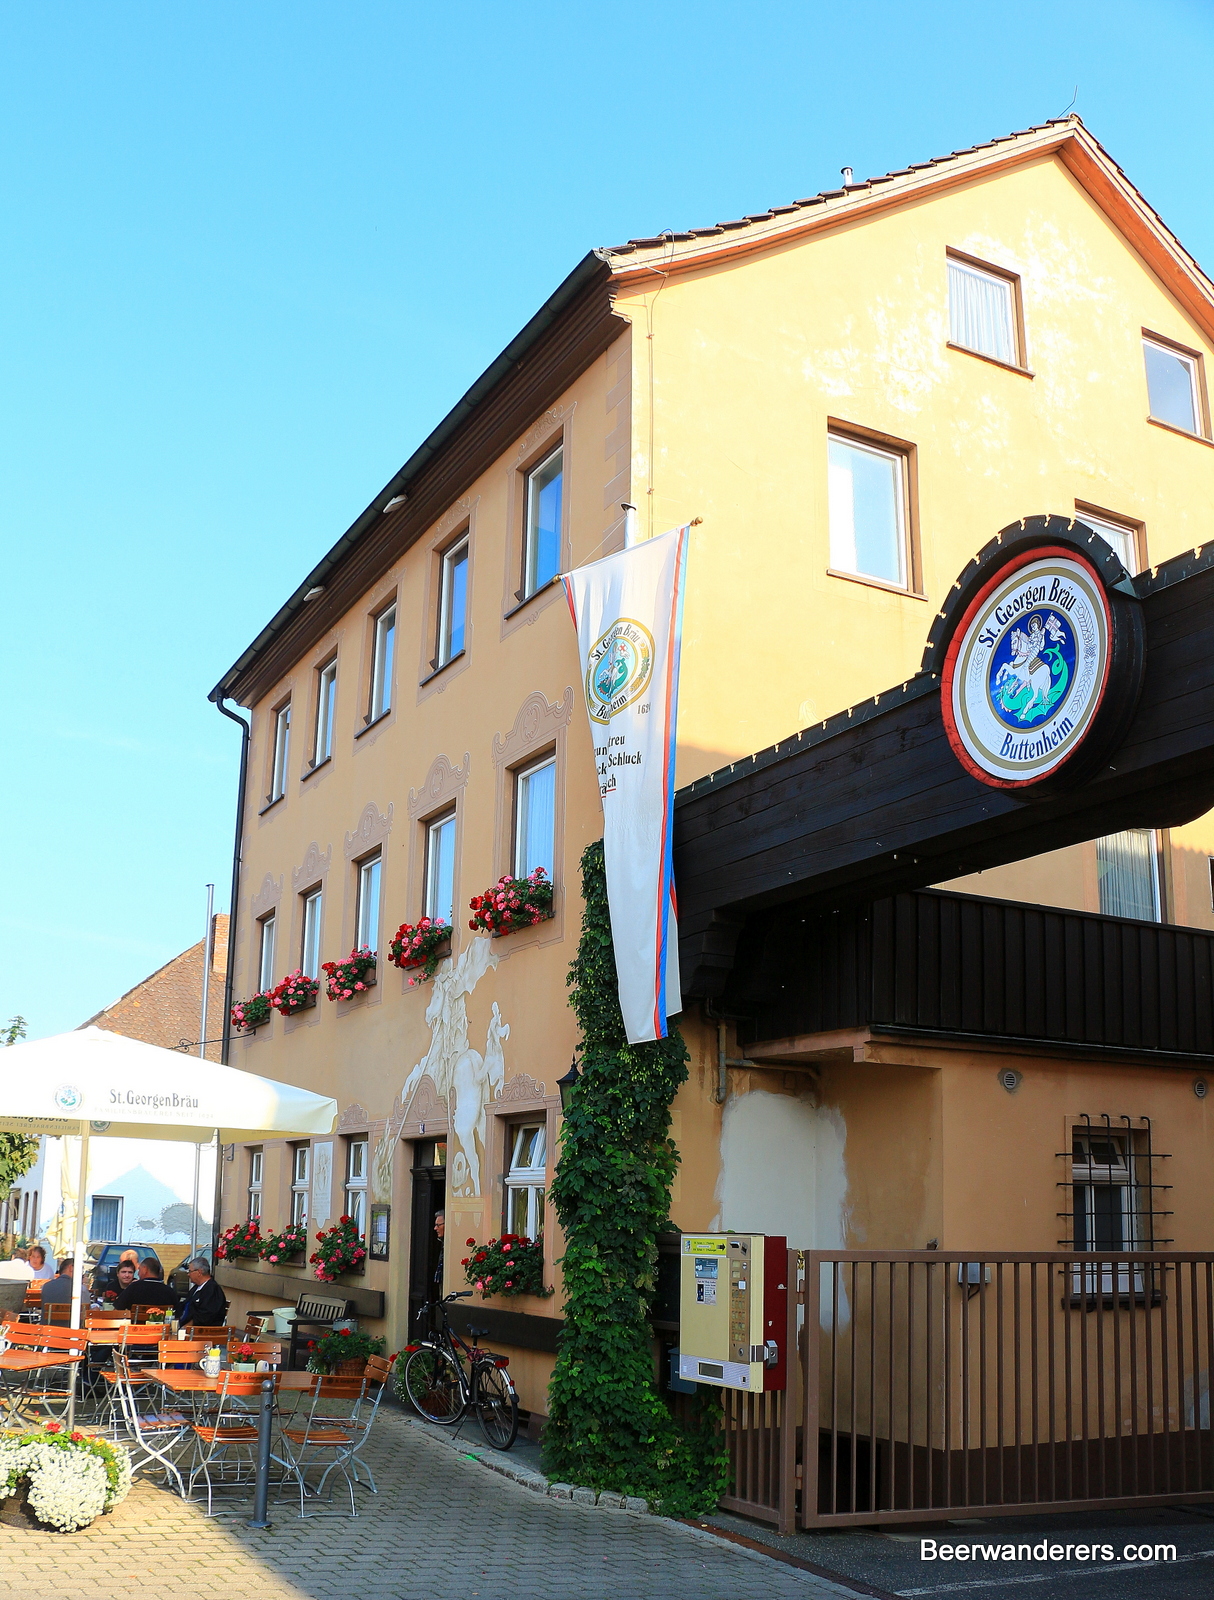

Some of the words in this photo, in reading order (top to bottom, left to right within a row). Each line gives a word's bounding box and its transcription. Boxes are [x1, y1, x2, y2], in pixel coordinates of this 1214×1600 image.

[978, 626, 1001, 649] St.
[995, 584, 1046, 625] Georgen
[1048, 577, 1077, 612] Bräu
[623, 624, 641, 644] Bräu
[1000, 716, 1074, 760] Buttenheim
[608, 751, 642, 768] Schluck
